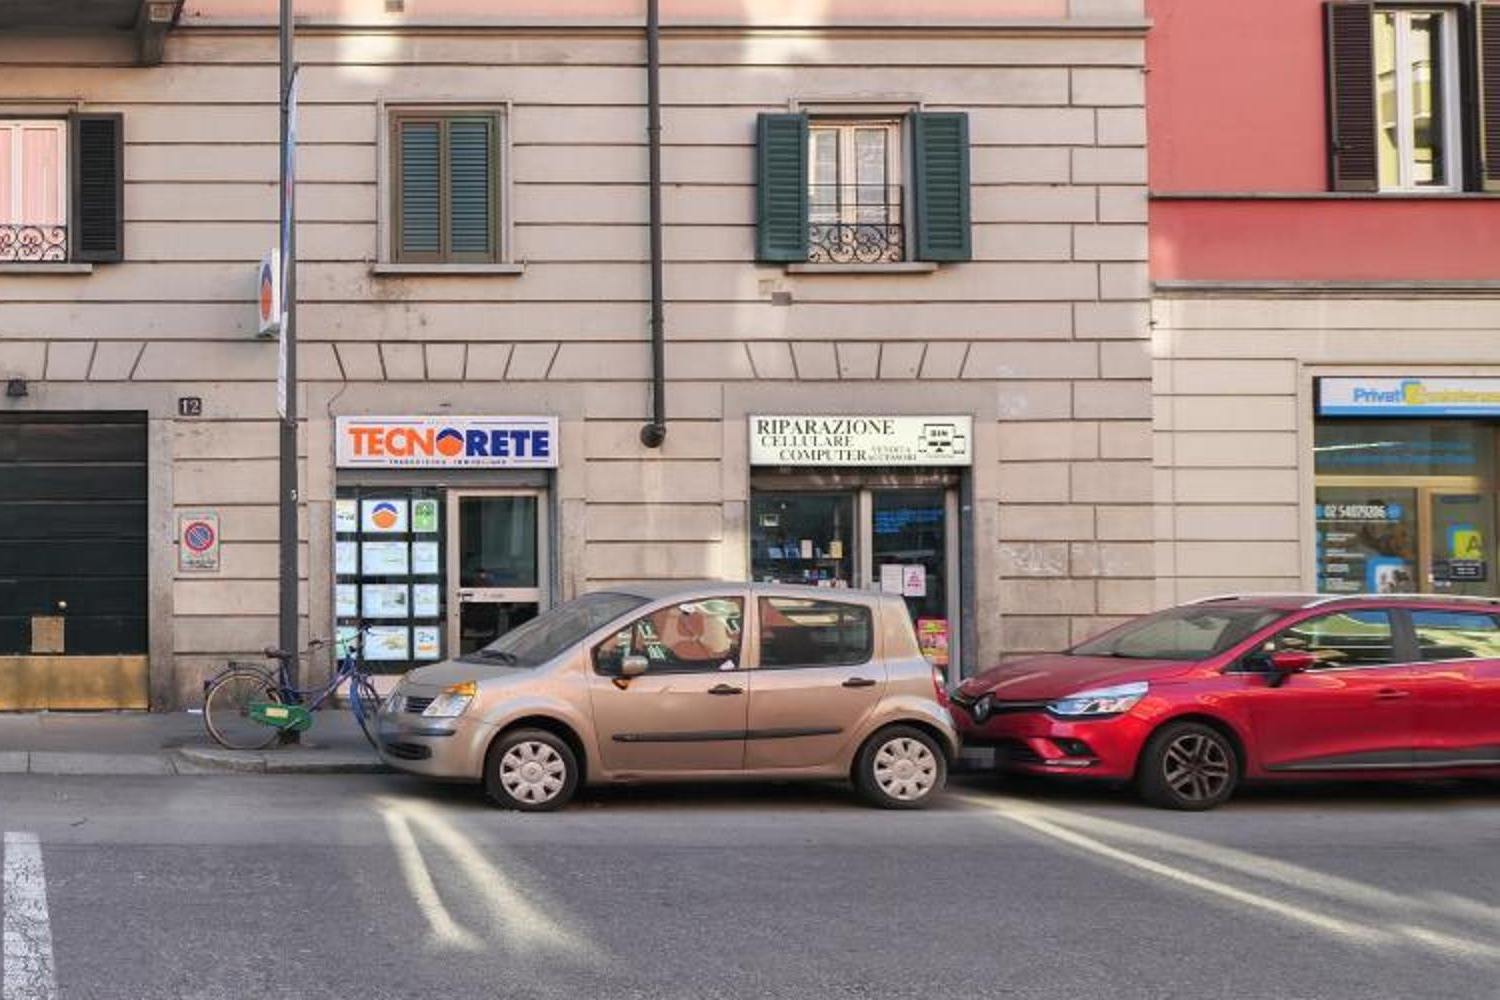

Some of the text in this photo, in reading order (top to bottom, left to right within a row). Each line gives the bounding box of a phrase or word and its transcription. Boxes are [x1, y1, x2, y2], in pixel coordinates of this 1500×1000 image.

[181, 399, 201, 415] 12
[757, 419, 895, 435] RIPARAZIONE
[347, 427, 550, 458] TECNORETE
[761, 435, 855, 447] CELLULARE
[779, 449, 867, 462] COMPUTER
